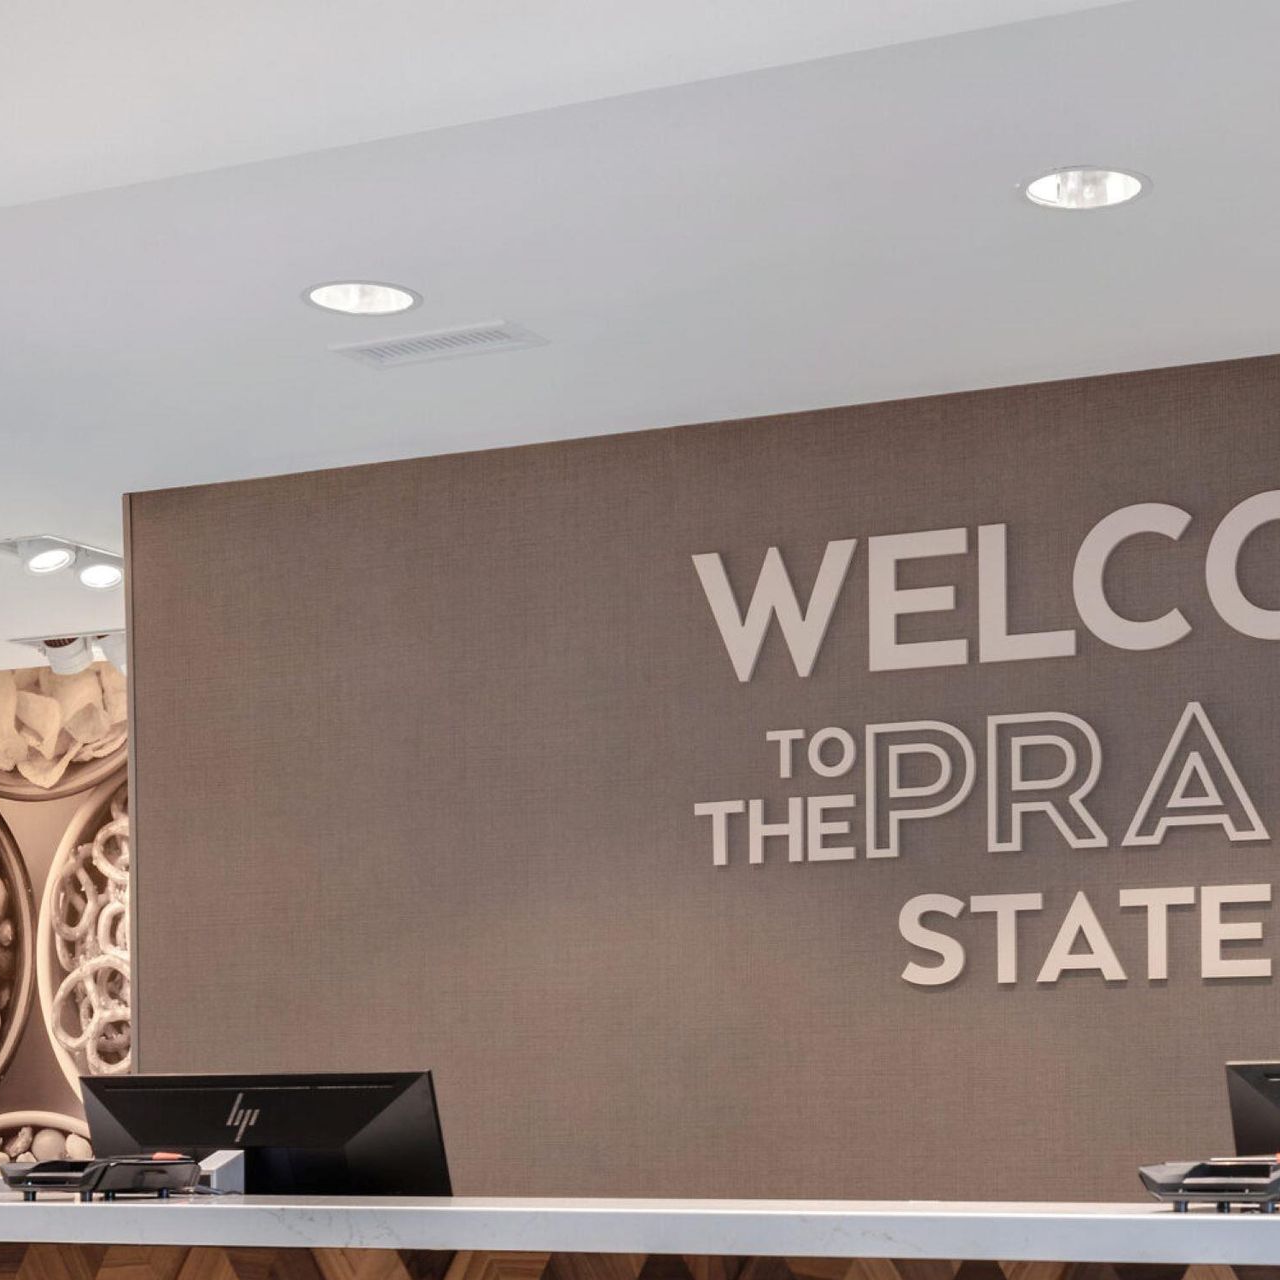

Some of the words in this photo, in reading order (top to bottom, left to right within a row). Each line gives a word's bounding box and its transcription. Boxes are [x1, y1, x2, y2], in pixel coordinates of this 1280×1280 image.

[766, 726, 856, 780] TO
[694, 795, 856, 866] THE
[898, 883, 1273, 986] STATE
